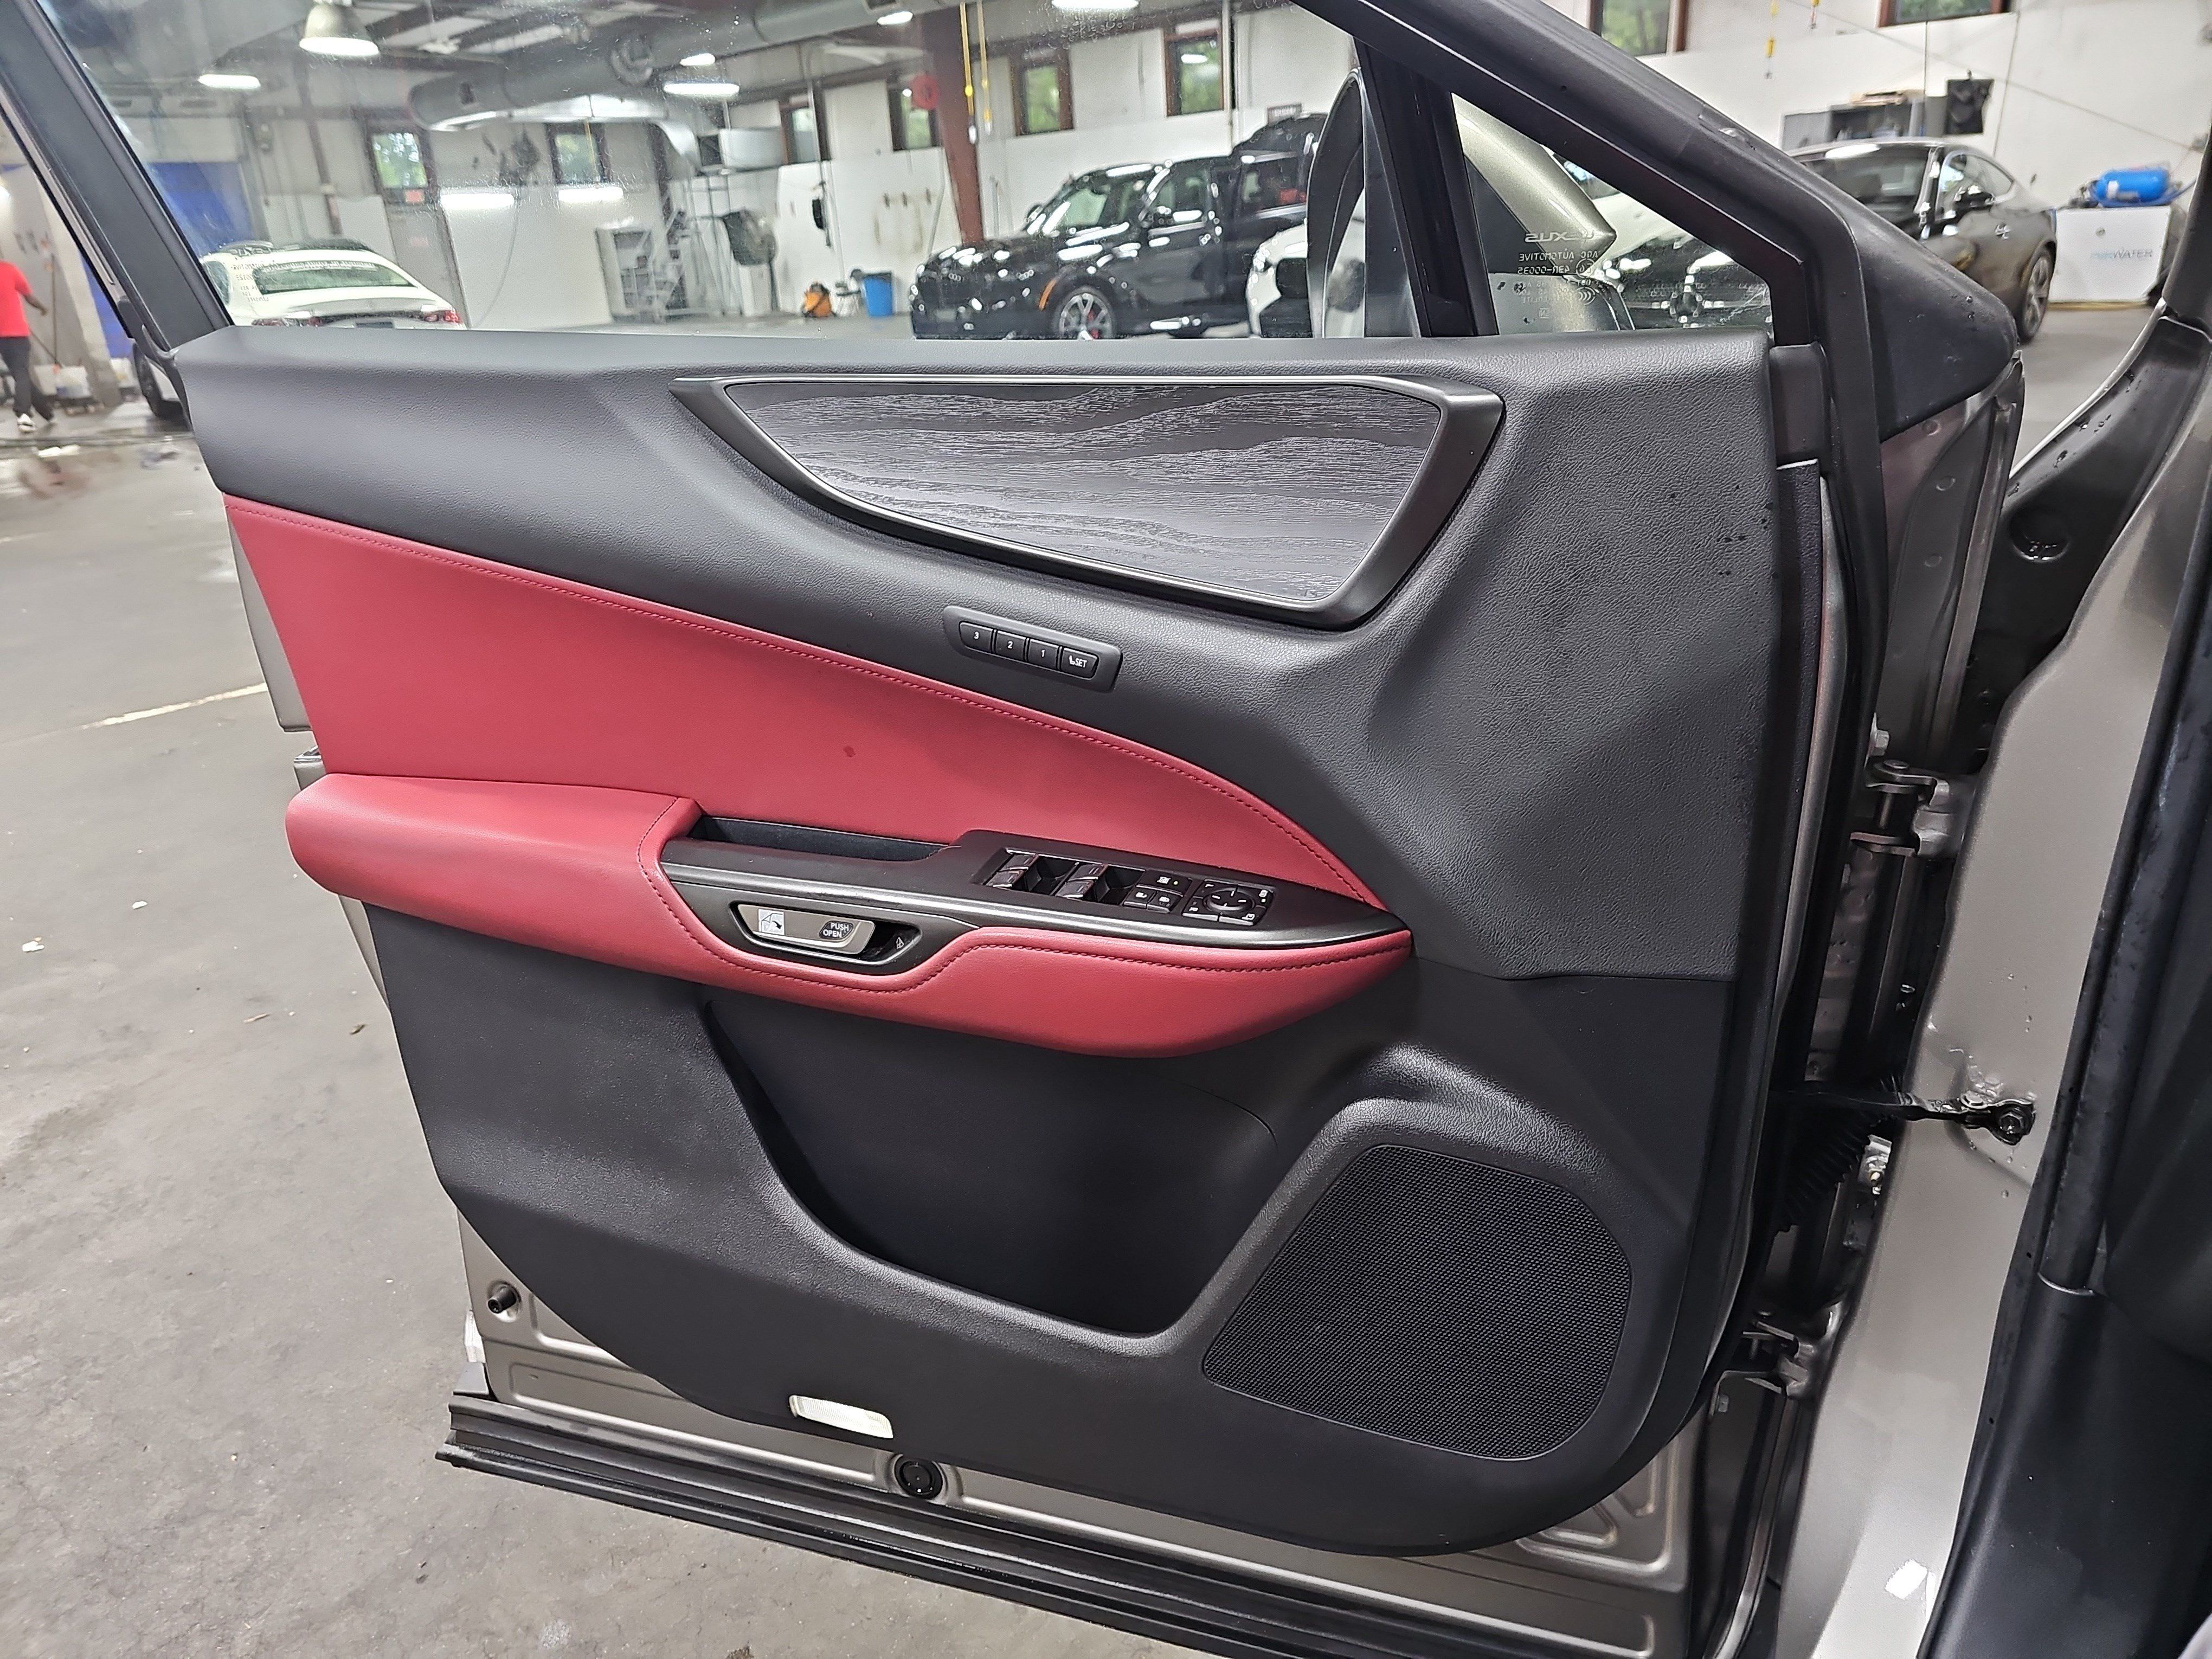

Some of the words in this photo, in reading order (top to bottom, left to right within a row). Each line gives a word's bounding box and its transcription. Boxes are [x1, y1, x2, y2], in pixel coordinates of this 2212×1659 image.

[1007, 641, 1013, 649] 2
[1041, 650, 1045, 658] 1
[1075, 658, 1088, 668] SET
[831, 922, 849, 931] PUSH
[822, 929, 842, 938] OPEN
